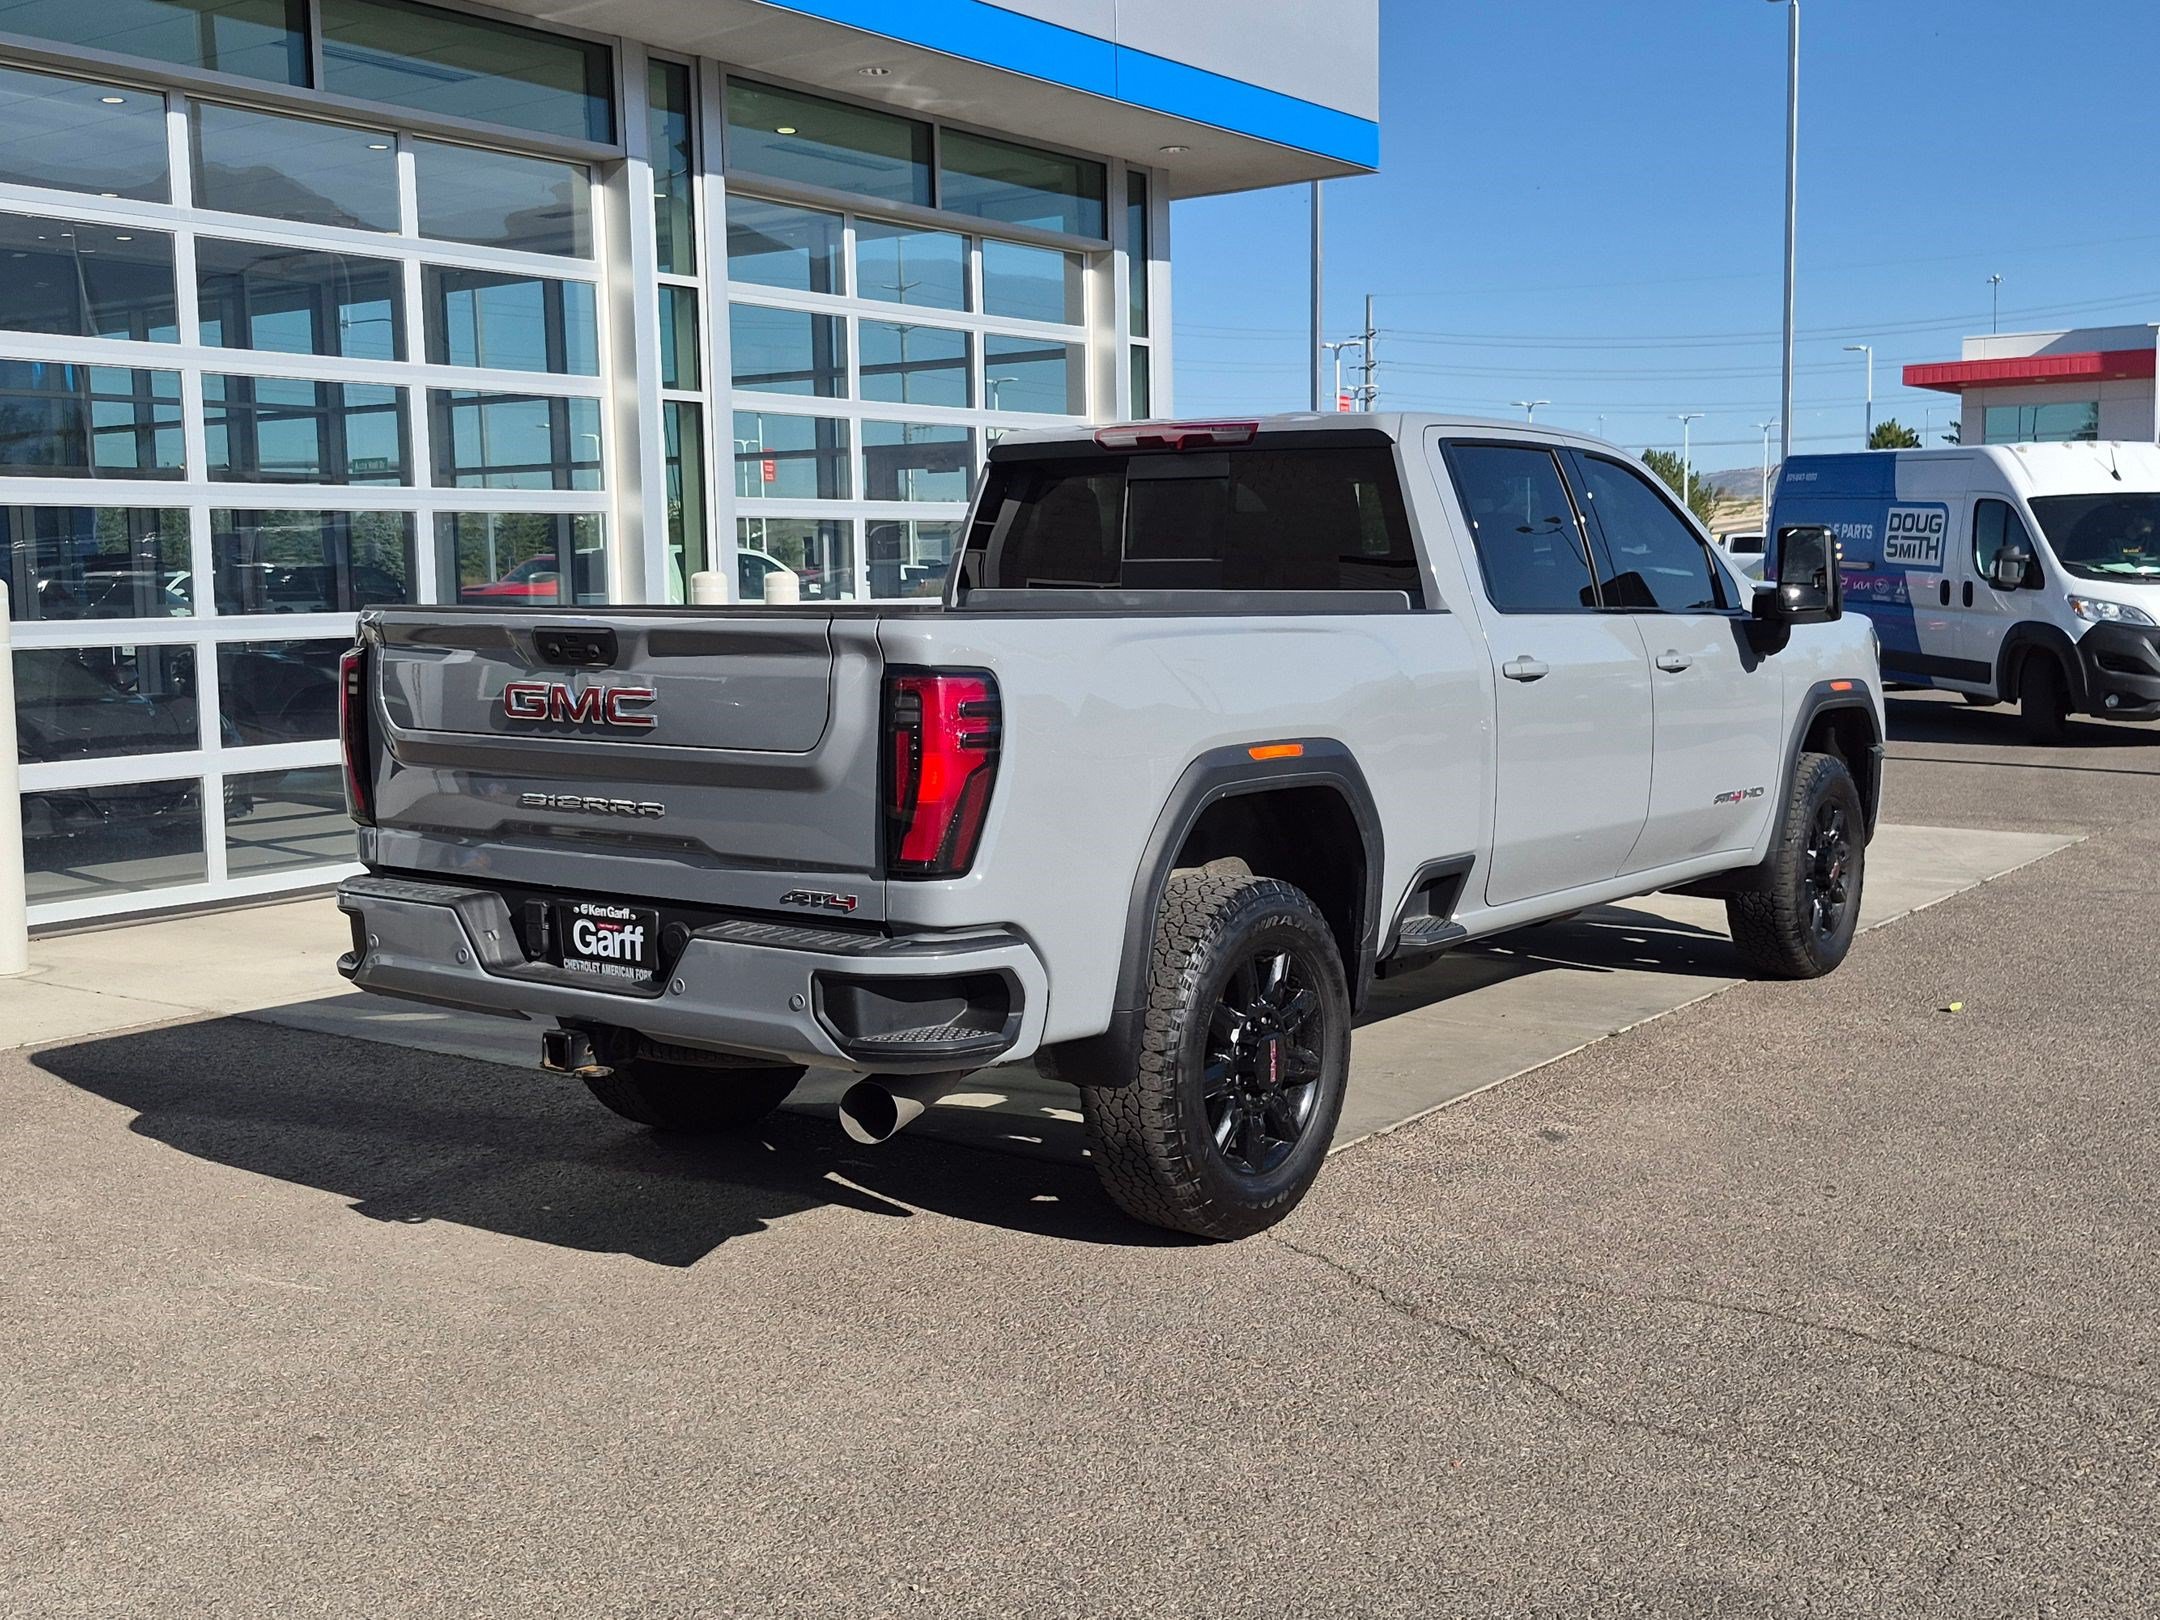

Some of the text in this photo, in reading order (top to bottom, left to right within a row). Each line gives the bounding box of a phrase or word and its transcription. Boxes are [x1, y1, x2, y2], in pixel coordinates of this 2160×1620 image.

[1841, 523, 1873, 540] PARTS
[1888, 513, 1943, 533] DOUG
[1886, 535, 1940, 560] SMITH
[503, 681, 658, 727] GMC
[520, 792, 666, 817] SIERRA
[589, 904, 630, 919] Ken Garff
[783, 888, 858, 912] AT4
[573, 918, 644, 961] Garff
[563, 958, 653, 981] CHEVROLET AMERICAN FORK
